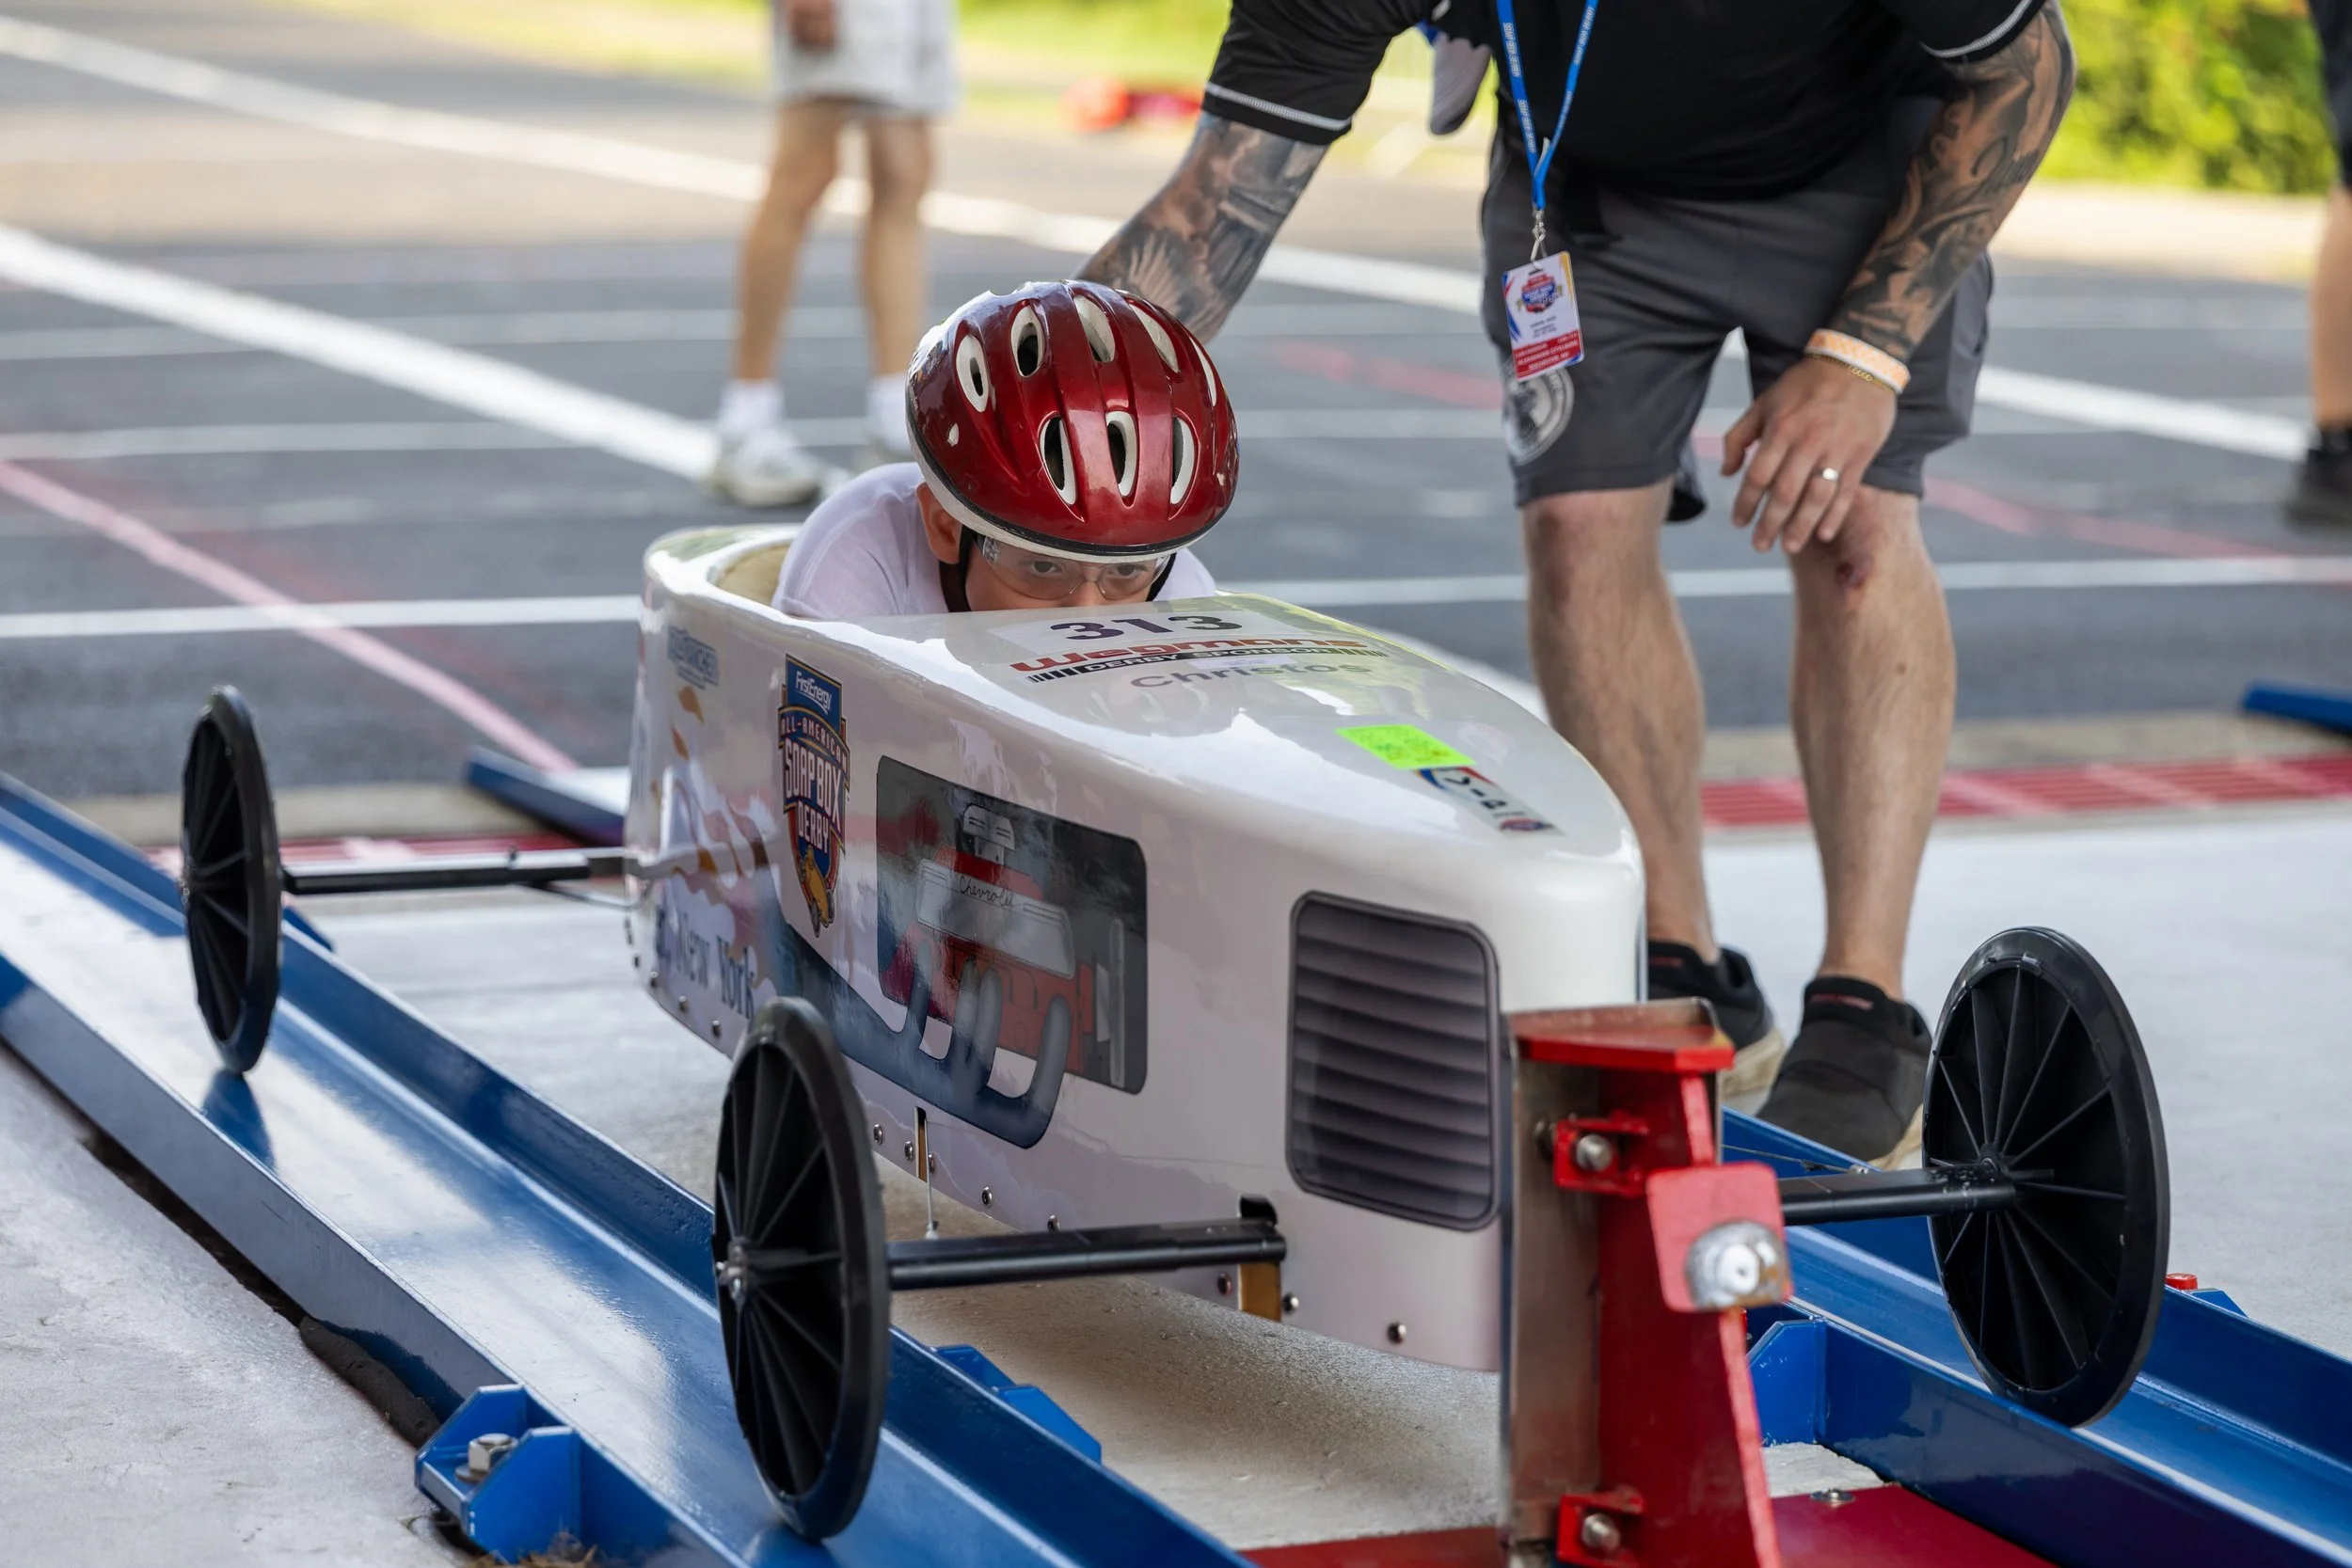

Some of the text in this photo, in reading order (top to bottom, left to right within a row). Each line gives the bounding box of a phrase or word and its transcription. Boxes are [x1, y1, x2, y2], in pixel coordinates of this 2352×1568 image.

[1050, 615, 1243, 641] 313
[1084, 647, 1329, 672] DERBY SPONSOR
[1131, 664, 1372, 688] Christos
[780, 715, 847, 771] ALL-AMERICAN
[786, 737, 842, 832] SOAP BOX
[798, 800, 830, 854] DERBY
[716, 934, 755, 1021] York
